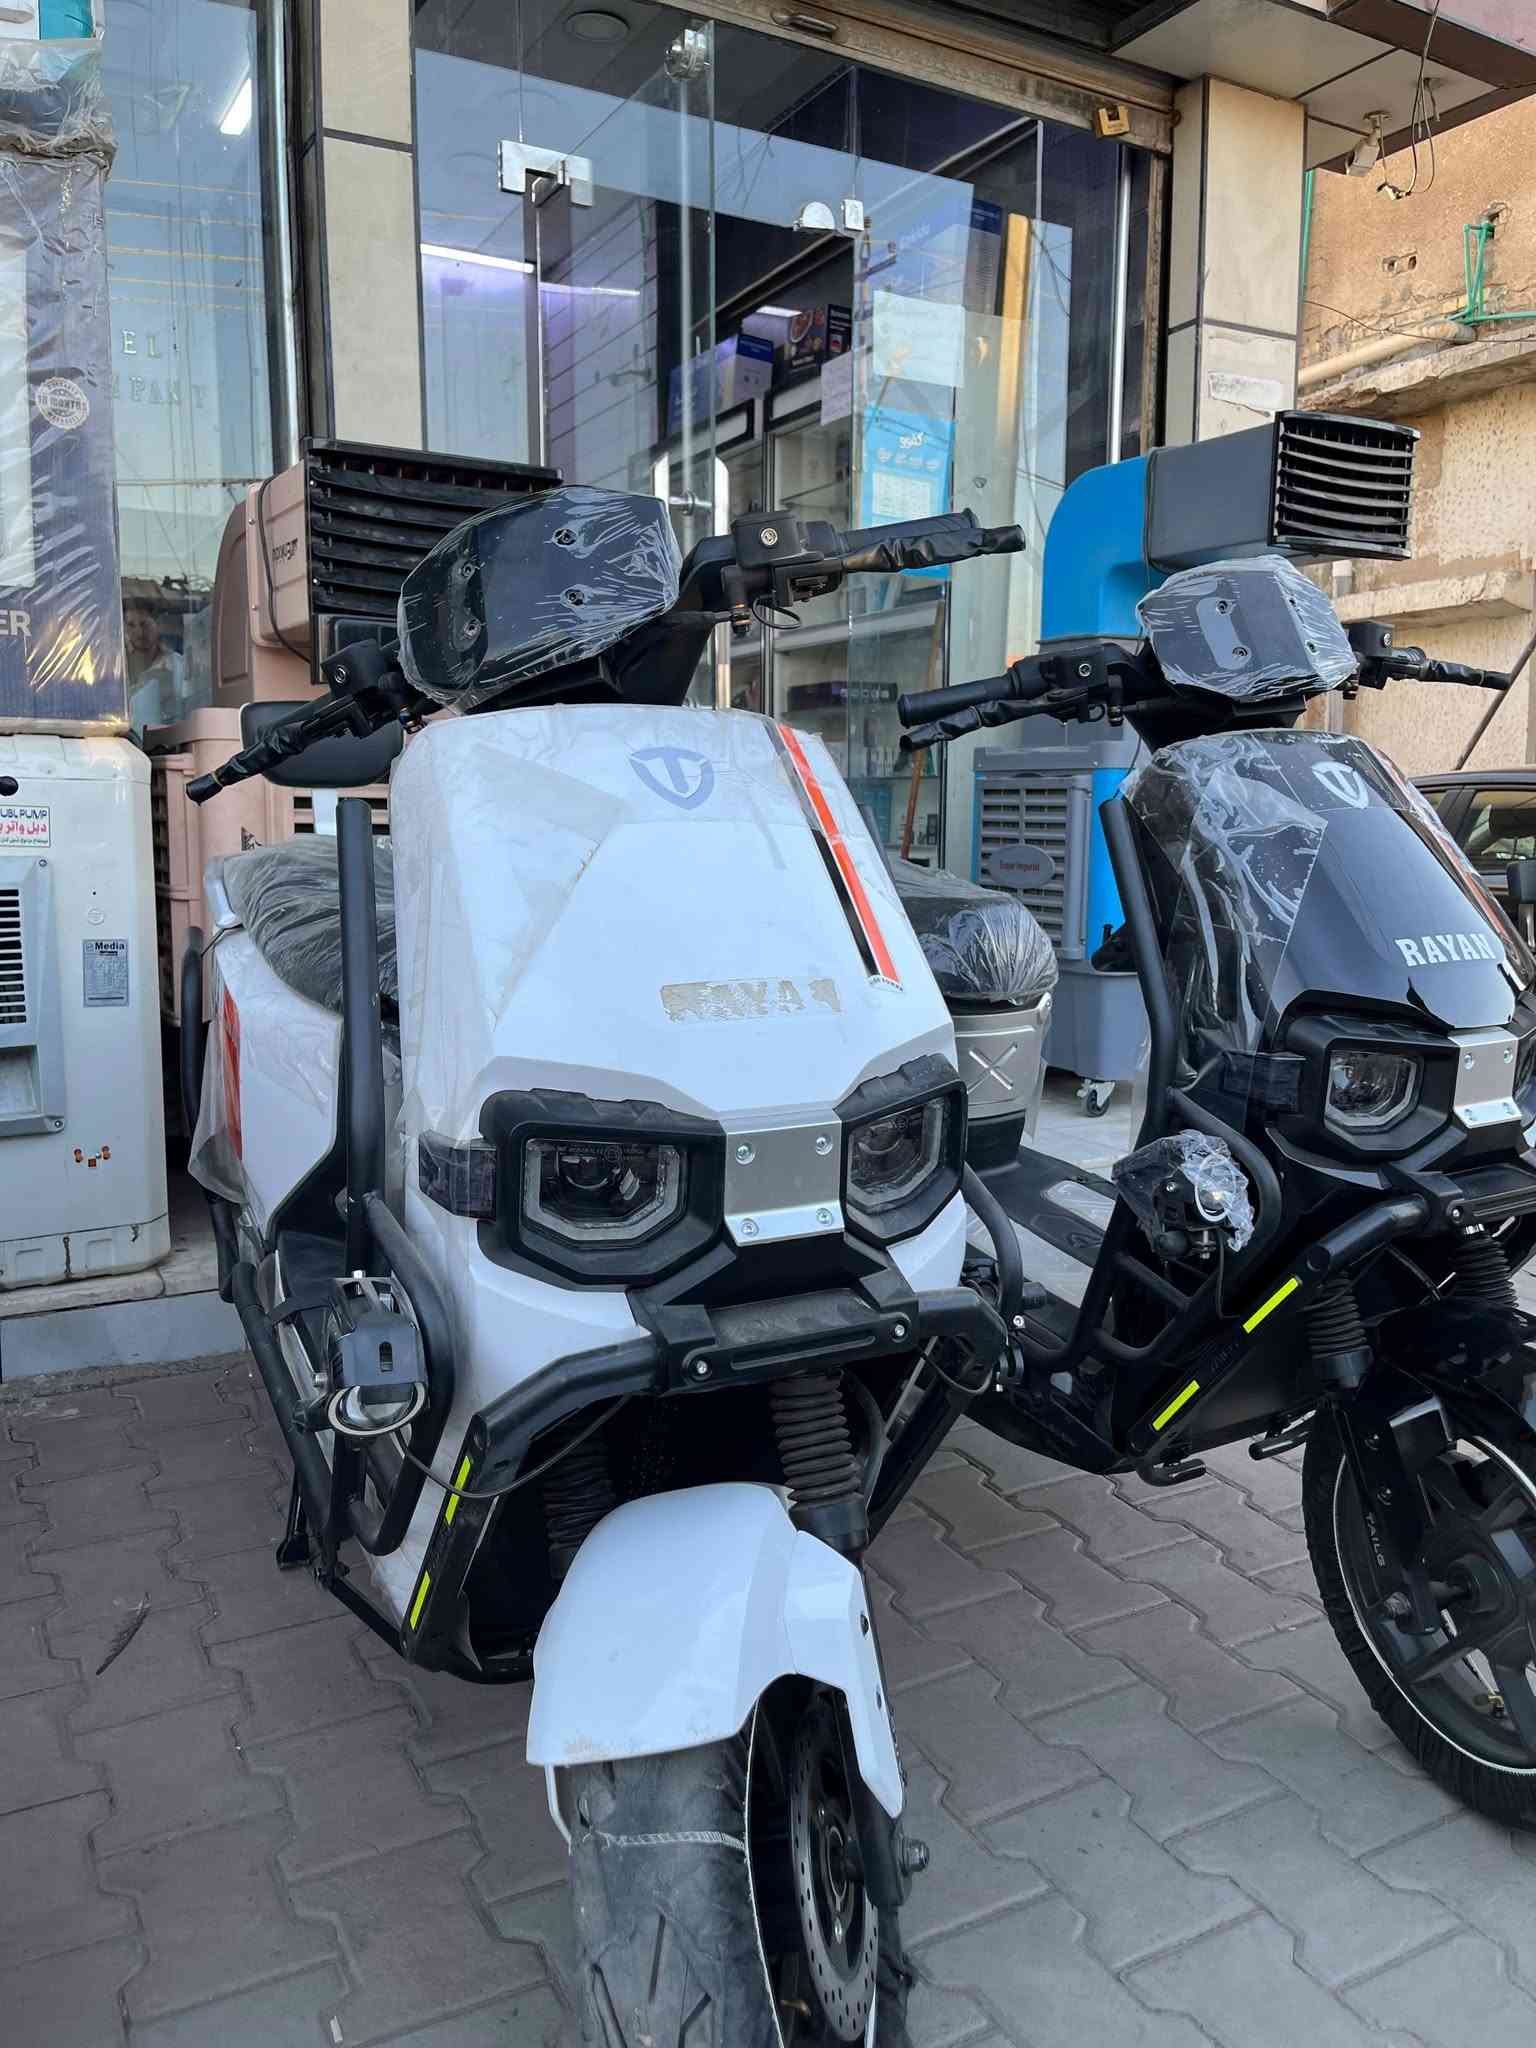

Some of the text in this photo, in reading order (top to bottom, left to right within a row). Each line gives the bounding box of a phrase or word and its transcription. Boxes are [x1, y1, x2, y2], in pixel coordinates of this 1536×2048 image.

[95, 941, 125, 951] Media
[1394, 933, 1497, 966] RAYAN
[1365, 1511, 1386, 1567] TAILG
